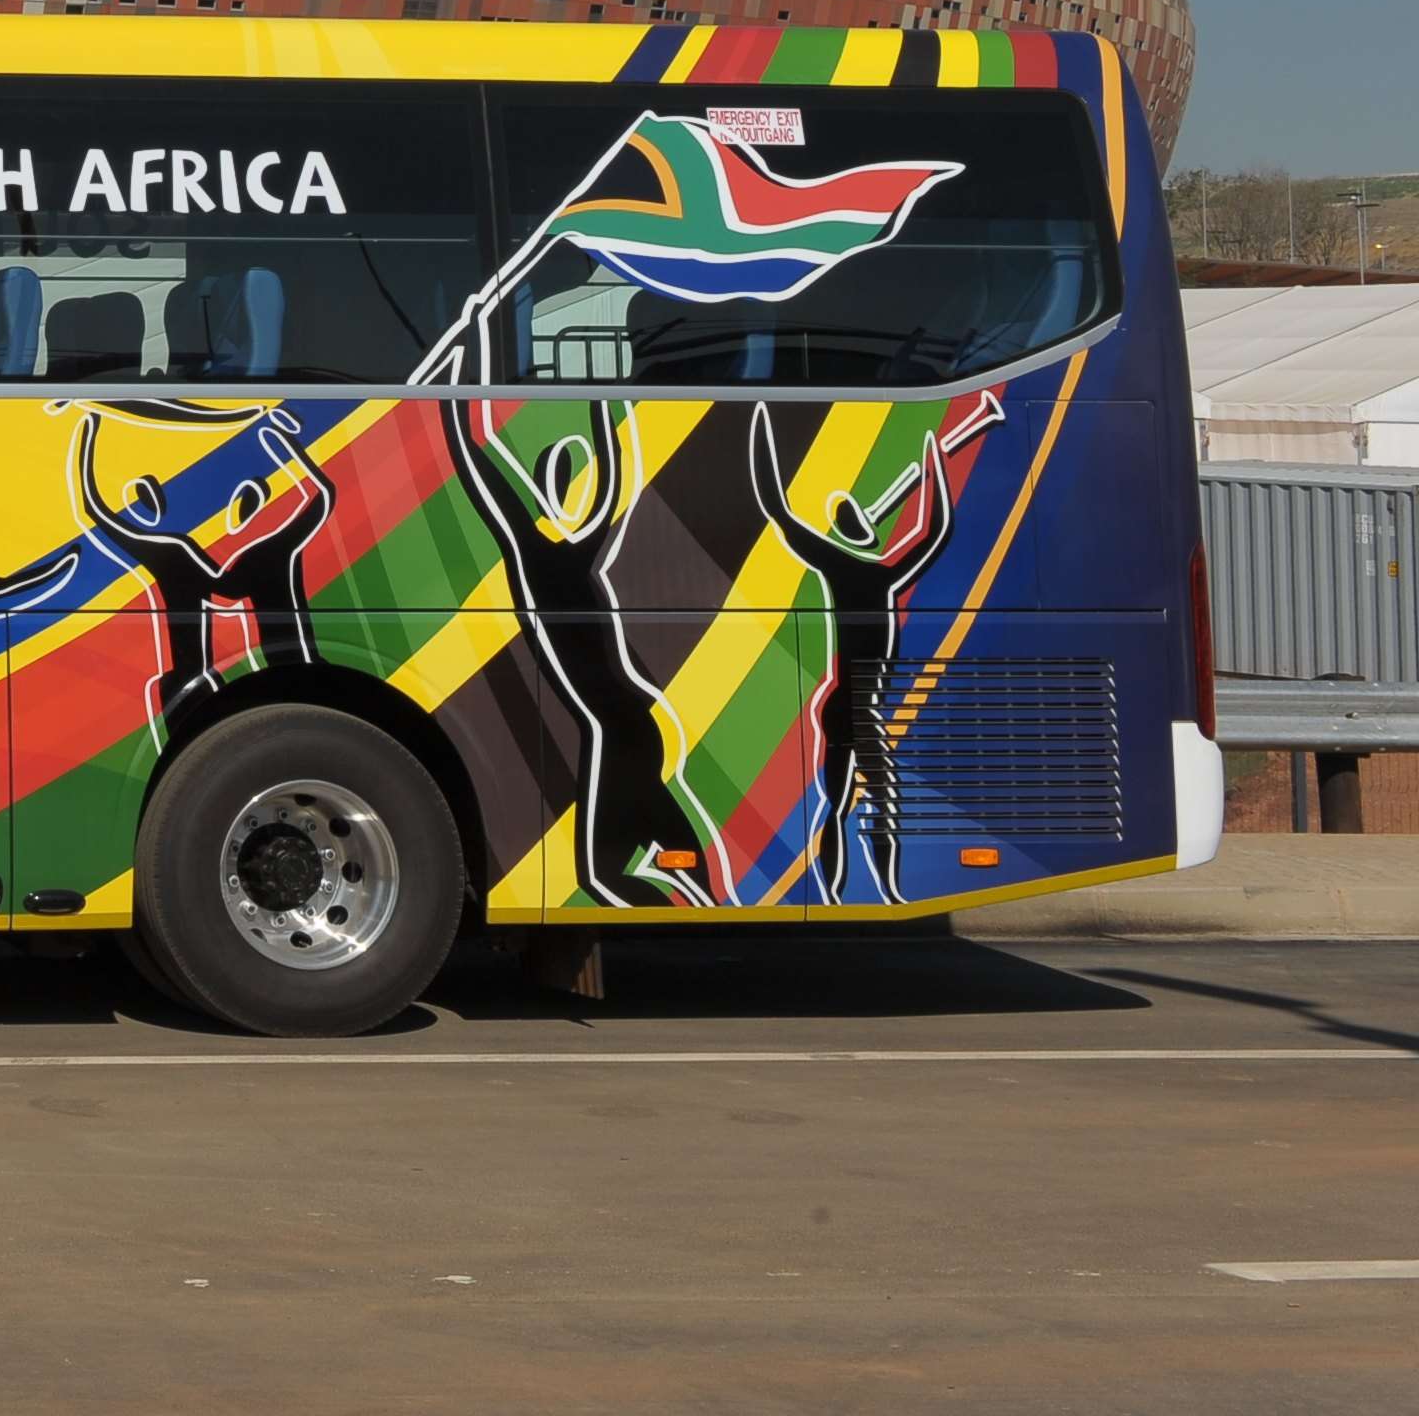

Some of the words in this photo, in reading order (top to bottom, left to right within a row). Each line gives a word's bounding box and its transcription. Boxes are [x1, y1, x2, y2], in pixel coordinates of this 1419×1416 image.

[708, 110, 771, 125] EMERGENCY
[776, 111, 800, 126] EXIT
[68, 148, 347, 215] AFRICA
